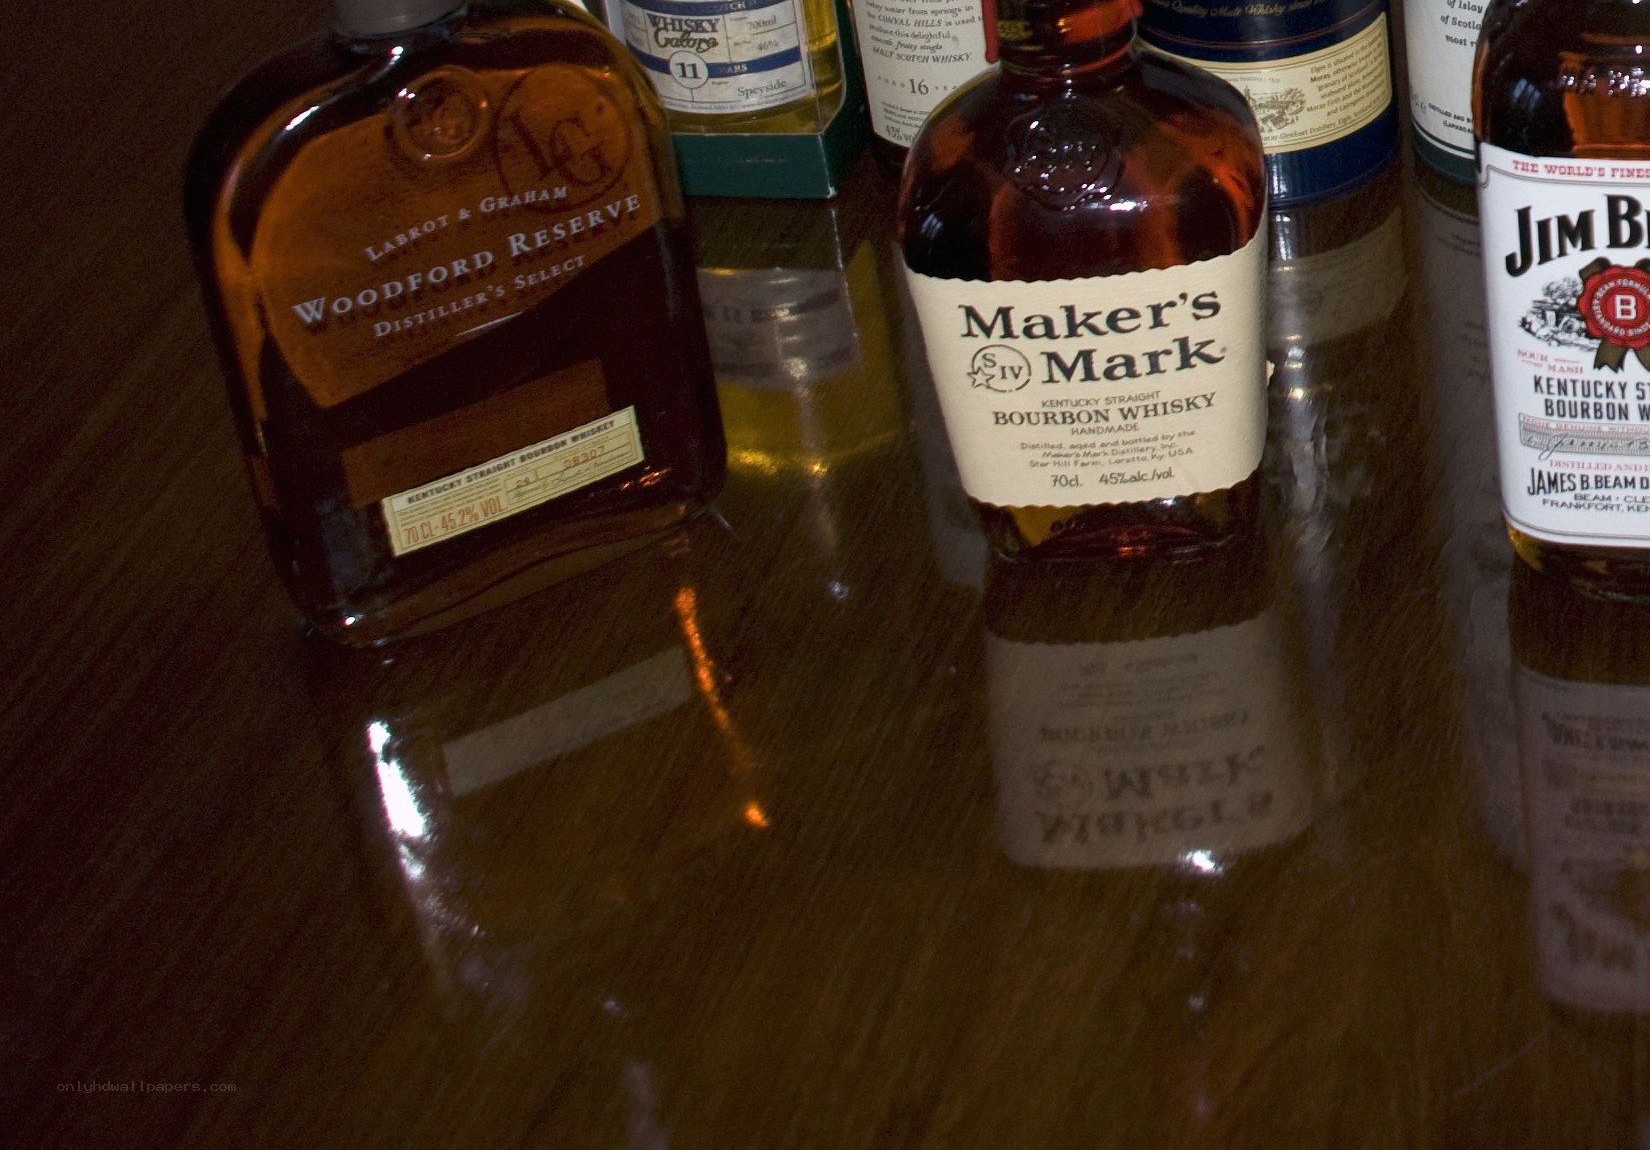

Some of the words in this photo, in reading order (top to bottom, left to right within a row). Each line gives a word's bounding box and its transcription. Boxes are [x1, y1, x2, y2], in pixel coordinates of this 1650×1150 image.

[1458, 0, 1484, 13] Islay
[646, 12, 721, 34] WHISKY
[653, 26, 720, 54] Galore
[675, 61, 702, 80] 11
[737, 78, 788, 100] Speyside
[907, 77, 930, 97] 16
[1512, 159, 1541, 175] THE
[1543, 163, 1606, 177] WORLD'S
[457, 208, 471, 221] &
[1503, 203, 1599, 279] JIM
[957, 290, 1222, 342] Maker's
[1613, 294, 1638, 321] B
[982, 352, 997, 369] S
[1040, 335, 1226, 385] Mark
[1516, 349, 1549, 363] SOUR
[1000, 364, 1024, 381] IV
[1546, 363, 1585, 376] MASH
[1532, 373, 1629, 401] KENTUCKY
[992, 407, 1111, 427] BOURBON
[1118, 391, 1217, 422] WHISKY
[1041, 397, 1101, 410] KENTUCKY
[1104, 390, 1162, 405] STRAIGHT
[1544, 397, 1630, 422] BOURBON
[1071, 422, 1140, 437] HANDMADE
[407, 477, 464, 504] KENTUCKY
[466, 458, 516, 484] STRAIGHT
[519, 438, 568, 464] BOURBON
[1549, 459, 1614, 472] DISTILLED
[1616, 461, 1643, 473] AND
[1527, 466, 1578, 498] JAMES
[1591, 474, 1637, 492] BEAM
[1573, 493, 1613, 503] BEAM
